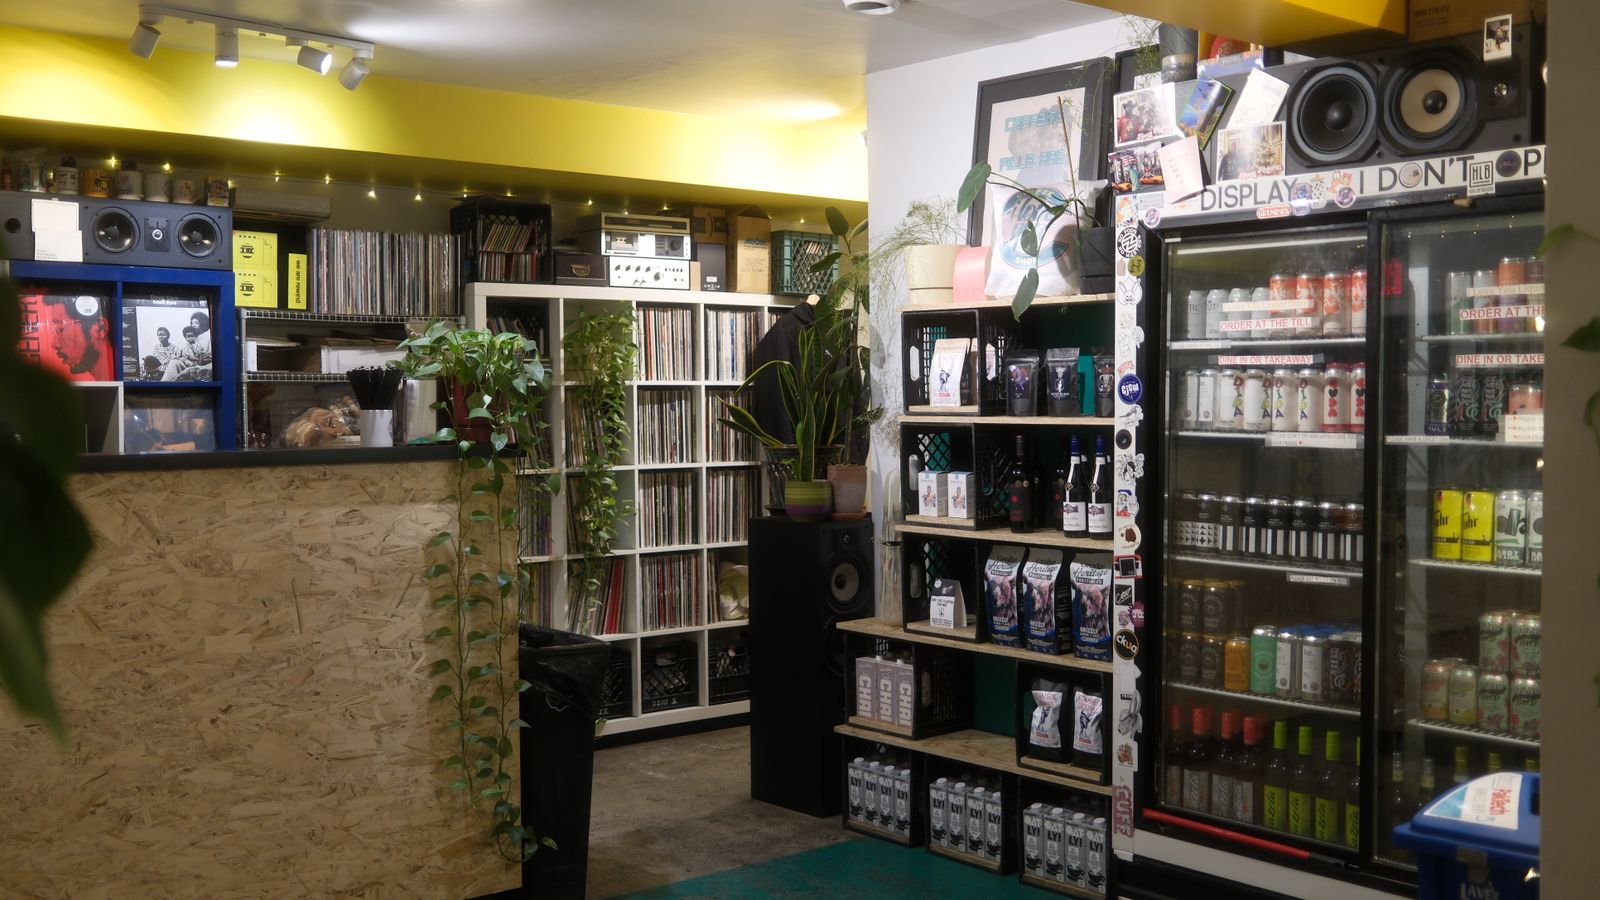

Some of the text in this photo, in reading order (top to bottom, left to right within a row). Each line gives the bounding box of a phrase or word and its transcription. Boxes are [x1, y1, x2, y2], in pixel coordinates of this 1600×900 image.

[1472, 164, 1491, 181] HLB
[1201, 178, 1298, 211] DISPLAY
[1379, 155, 1474, 191] DN'T
[1460, 308, 1501, 319] ORDER
[1505, 307, 1520, 317] AT
[1220, 318, 1311, 330] ORDER AT THE TILL
[1219, 356, 1238, 364] DINE
[1264, 356, 1312, 364] TAKEAWAY
[1456, 356, 1481, 364] DINE
[1483, 356, 1494, 364] IN
[1496, 355, 1512, 363] OR
[1116, 634, 1138, 653] ckua
[859, 675, 872, 718] CHAI
[879, 678, 892, 722] CHAI
[899, 682, 912, 726] CHAI
[1027, 825, 1040, 837] LY!
[1047, 830, 1061, 842] LY!
[1068, 835, 1082, 847] LY!
[1090, 840, 1103, 853] LY!
